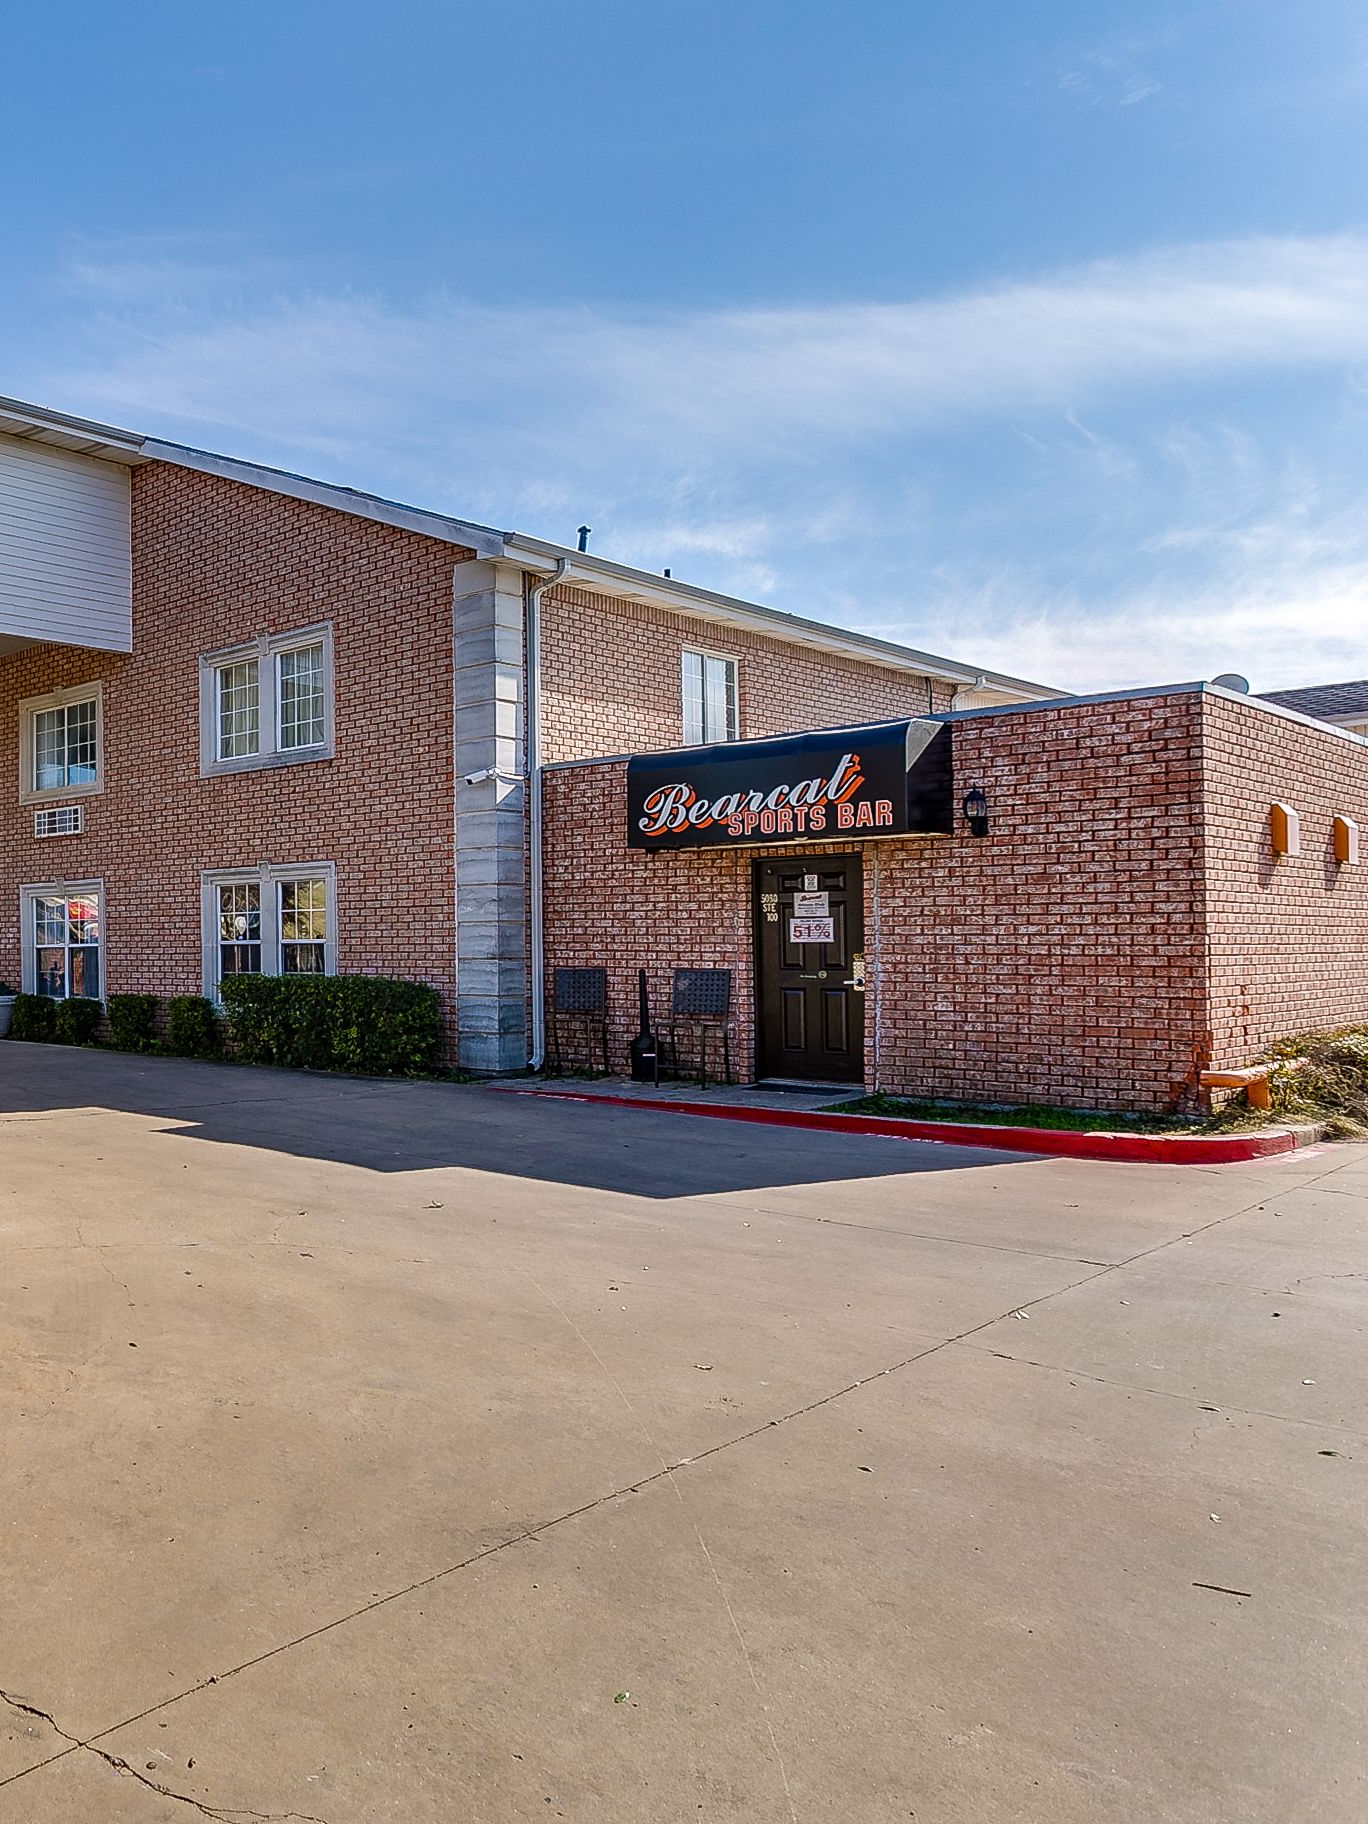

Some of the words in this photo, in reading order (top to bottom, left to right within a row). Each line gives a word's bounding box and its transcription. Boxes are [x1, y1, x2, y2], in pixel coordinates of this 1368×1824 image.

[638, 753, 865, 837] Bearcat
[728, 805, 827, 836] SPORTS
[837, 799, 893, 829] BAR
[762, 903, 776, 912] STE
[766, 913, 778, 921] 100
[793, 925, 831, 938] 51%
